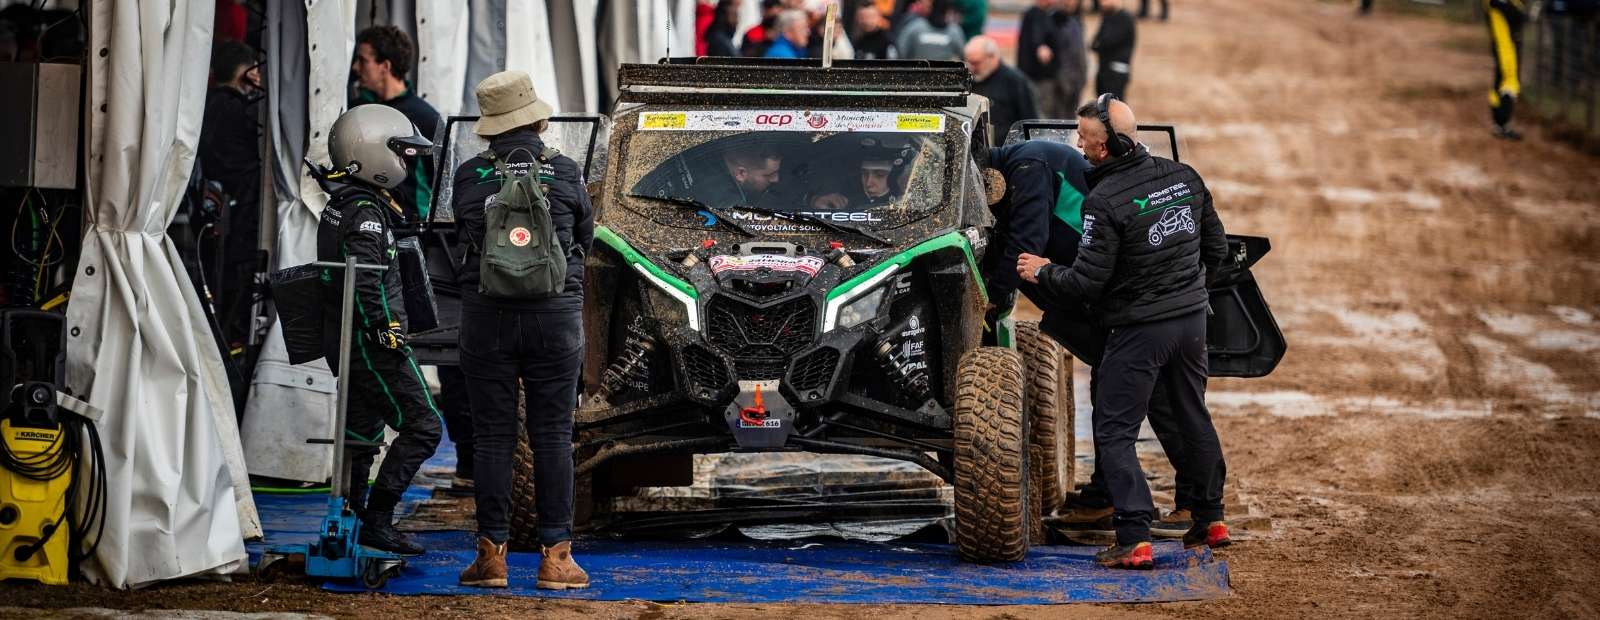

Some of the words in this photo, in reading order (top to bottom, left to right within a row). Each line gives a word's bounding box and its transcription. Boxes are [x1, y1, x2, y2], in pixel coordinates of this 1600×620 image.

[755, 114, 793, 127] acp
[1147, 182, 1188, 199] MOMSTEEL
[1150, 195, 1173, 206] RACING
[1173, 188, 1191, 198] TEAM
